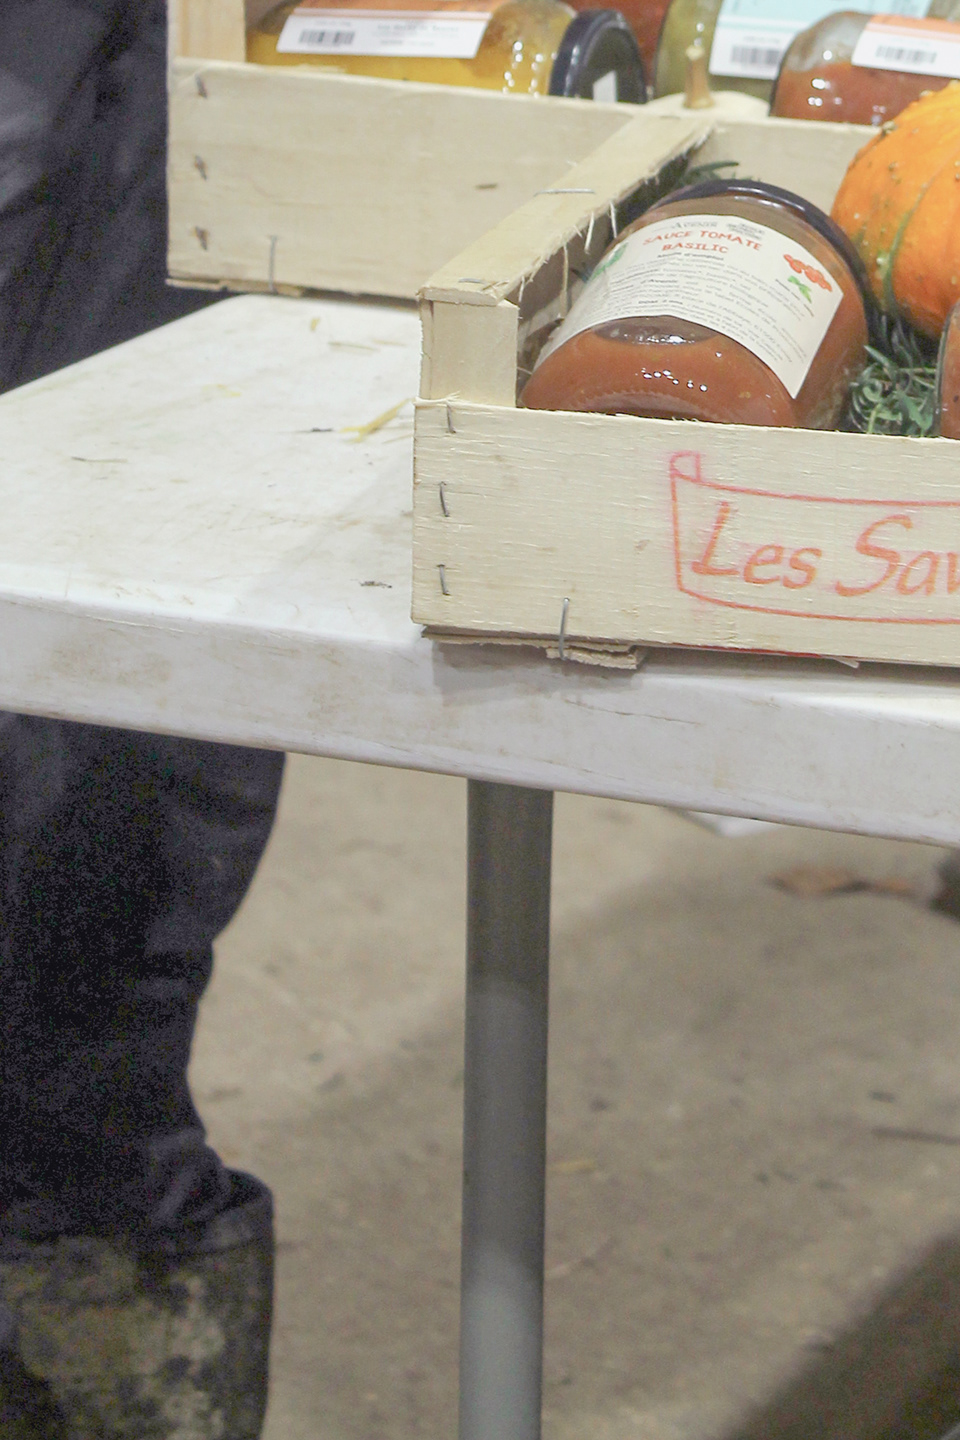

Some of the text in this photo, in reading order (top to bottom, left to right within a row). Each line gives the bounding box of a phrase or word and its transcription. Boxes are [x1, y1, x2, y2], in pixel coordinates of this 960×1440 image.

[642, 230, 693, 246] SAUCE
[700, 230, 763, 251] TOMATE
[662, 242, 729, 254] BASILIC
[690, 501, 823, 590] Les
